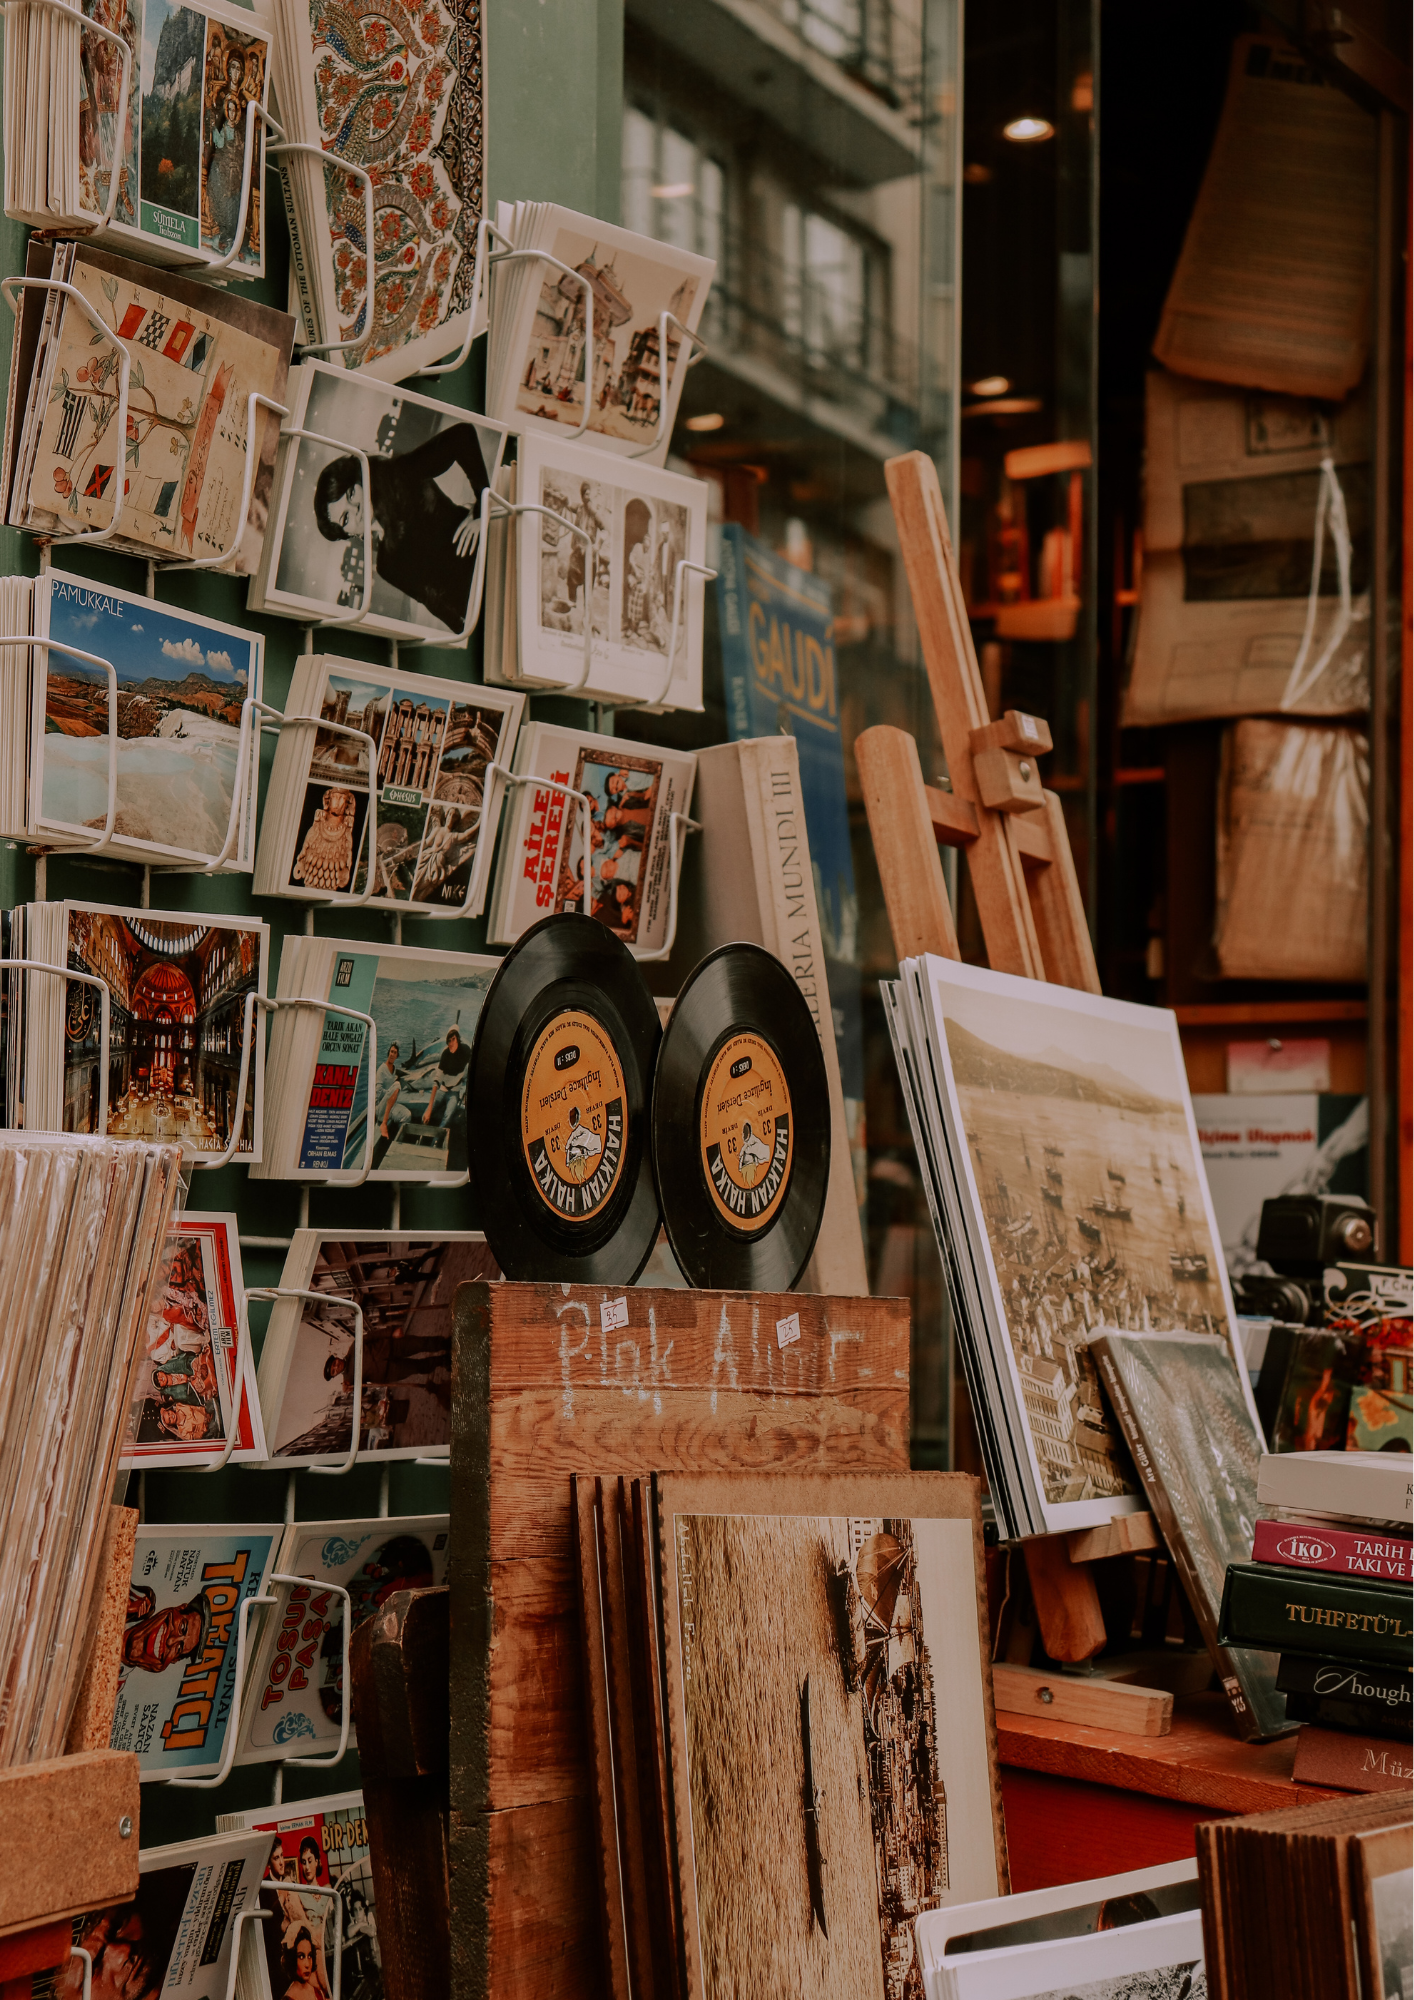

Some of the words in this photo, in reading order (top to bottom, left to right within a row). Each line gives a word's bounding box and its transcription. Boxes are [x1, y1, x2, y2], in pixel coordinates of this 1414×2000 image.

[279, 166, 295, 214] SULTANS
[290, 217, 305, 271] OTTOMAN
[299, 273, 309, 296] THE
[303, 299, 312, 314] OF
[308, 318, 317, 345] URES
[52, 580, 124, 618] PAMUKKALE
[389, 789, 417, 803] EPHESUS
[771, 771, 793, 797] III
[523, 789, 551, 884] AİLE
[776, 810, 808, 921] MUNDI
[441, 883, 466, 900] NIKE
[791, 929, 823, 1040] LERIA
[322, 1031, 339, 1041] HALE
[345, 1022, 363, 1033] AKAN
[309, 1086, 355, 1109] DENİZ
[539, 1085, 568, 1111] Dersleri
[717, 1092, 743, 1115] Dersleri
[591, 1113, 602, 1131] 33
[762, 1119, 772, 1136] 33
[199, 1138, 221, 1150] HAGIA
[224, 1138, 253, 1151] SHIA
[550, 1134, 561, 1153] 33
[727, 1137, 737, 1154] 33
[581, 1115, 622, 1211] HALKTAN
[751, 1127, 788, 1214] HALKTAN
[533, 1149, 576, 1213] HALKA
[711, 1158, 747, 1215] HALKA
[211, 1328, 221, 1356] ERTEM
[1136, 1443, 1149, 1467] Güler
[1145, 1464, 1156, 1482] Ara
[1289, 1538, 1323, 1559] İKO
[1353, 1540, 1404, 1560] TARİH
[173, 1549, 190, 1594] BAYTAN
[181, 1549, 197, 1588] NATUK
[1345, 1555, 1381, 1573] TAKI
[1386, 1561, 1406, 1577] VE
[159, 1549, 252, 1752] TOKATÇI
[261, 1574, 315, 1711] TOSUN
[288, 1590, 333, 1692] PAŞA
[214, 1656, 237, 1729] SUNAL
[1313, 1665, 1412, 1706] Though
[142, 1703, 159, 1754] NAZAN
[321, 1820, 344, 1852] BİR
[185, 1866, 208, 1915] tezcan
